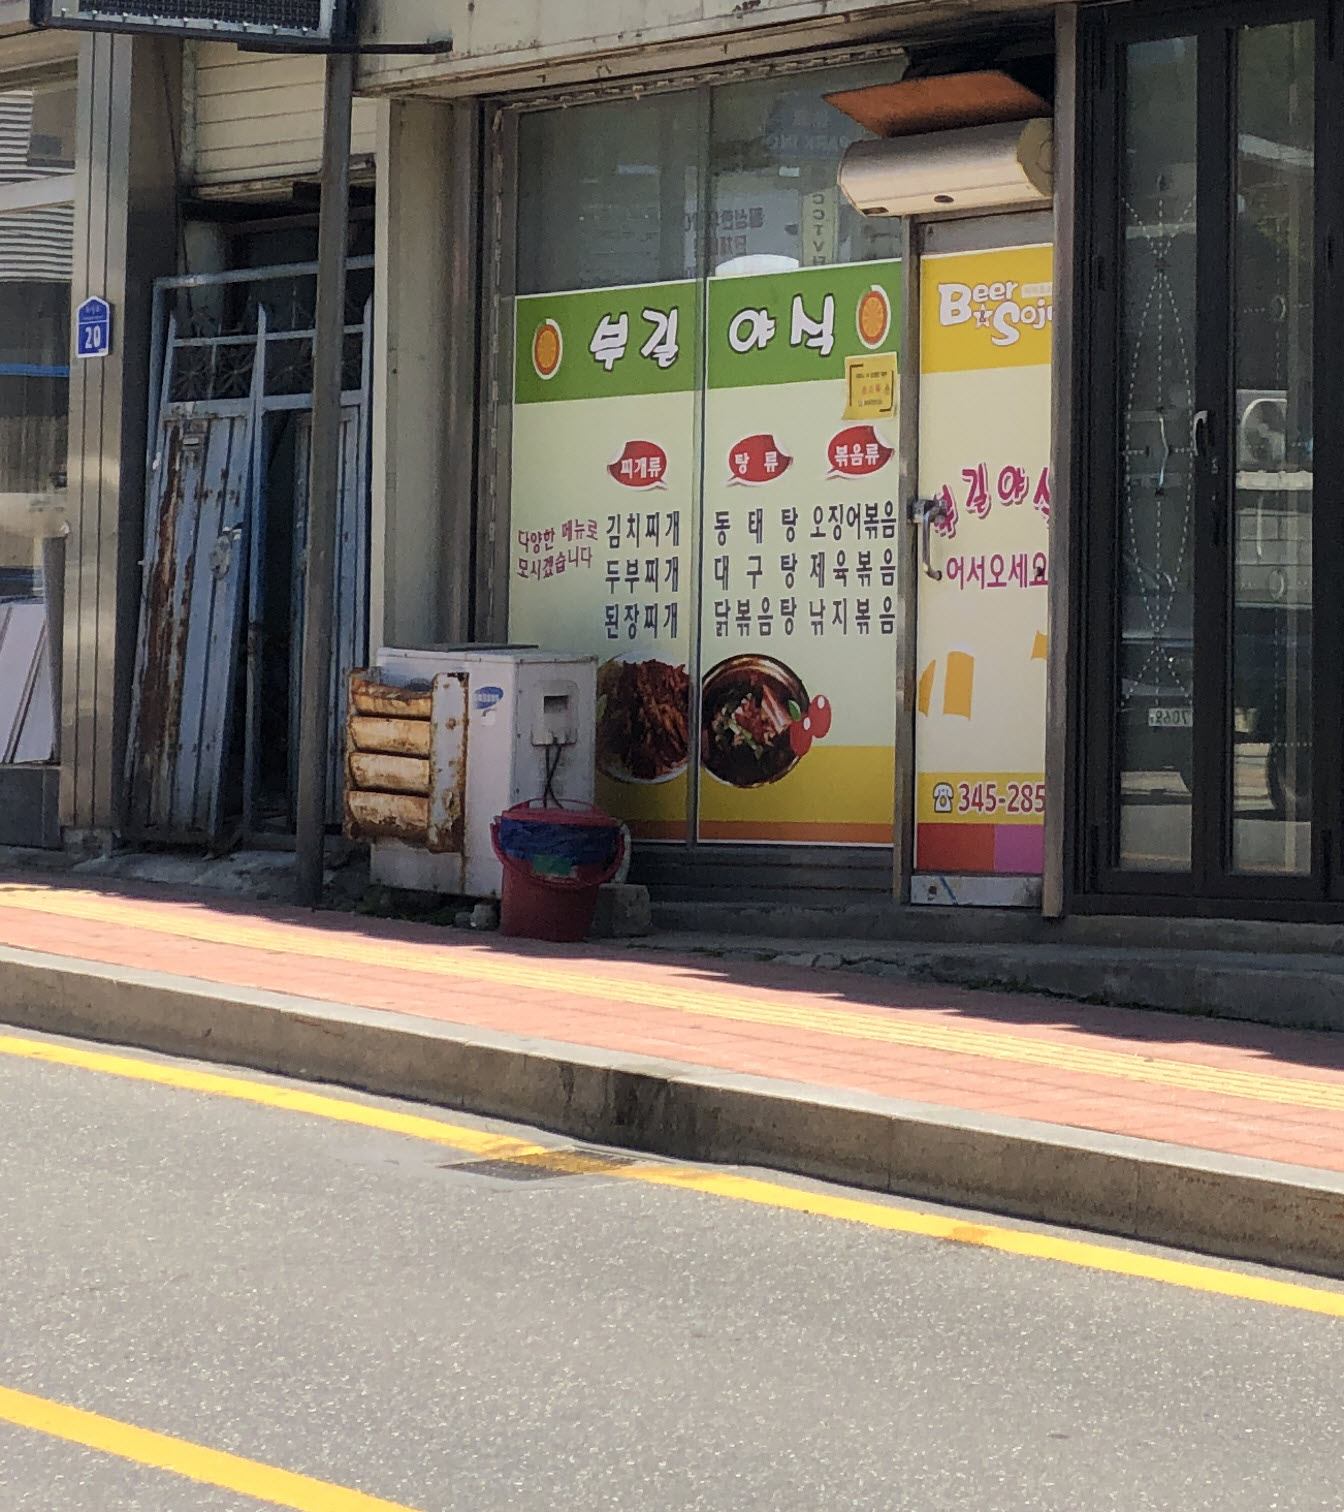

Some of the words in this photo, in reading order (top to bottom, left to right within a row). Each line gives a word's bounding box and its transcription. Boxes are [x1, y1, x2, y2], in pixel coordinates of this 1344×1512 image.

[937, 280, 1019, 326] Beer
[991, 297, 1053, 347] Soj
[85, 325, 100, 349] 20
[620, 455, 662, 479] 찌개류
[834, 443, 880, 468] 볶음류
[517, 527, 556, 555] 다양한
[561, 519, 599, 542] 메뉴로
[606, 510, 680, 549] 김치찌개
[810, 500, 897, 541] 오징어볶음
[517, 546, 593, 581] 모시겠습니다
[605, 556, 679, 594] 두부찌개
[810, 548, 896, 588] 제육볶음
[946, 552, 1049, 590] 어서오세요
[604, 602, 678, 639] 된장찌개
[714, 597, 798, 637] 닭볶음탕
[958, 783, 1046, 813] 345-285
